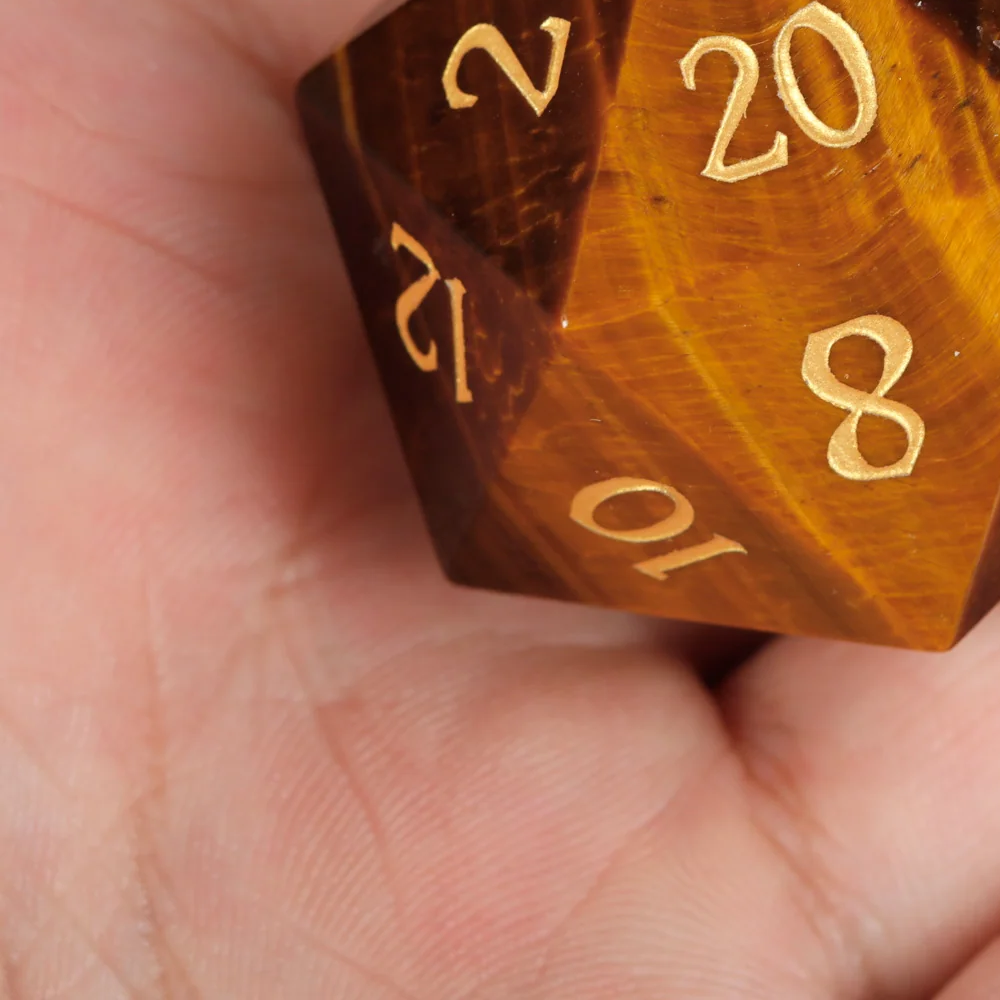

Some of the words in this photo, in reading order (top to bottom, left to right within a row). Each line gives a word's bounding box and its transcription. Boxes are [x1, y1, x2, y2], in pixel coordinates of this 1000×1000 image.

[441, 16, 572, 117] 2
[680, 0, 878, 183] 20
[391, 222, 473, 403] 12
[801, 314, 926, 481] 8
[569, 476, 748, 581] 10
